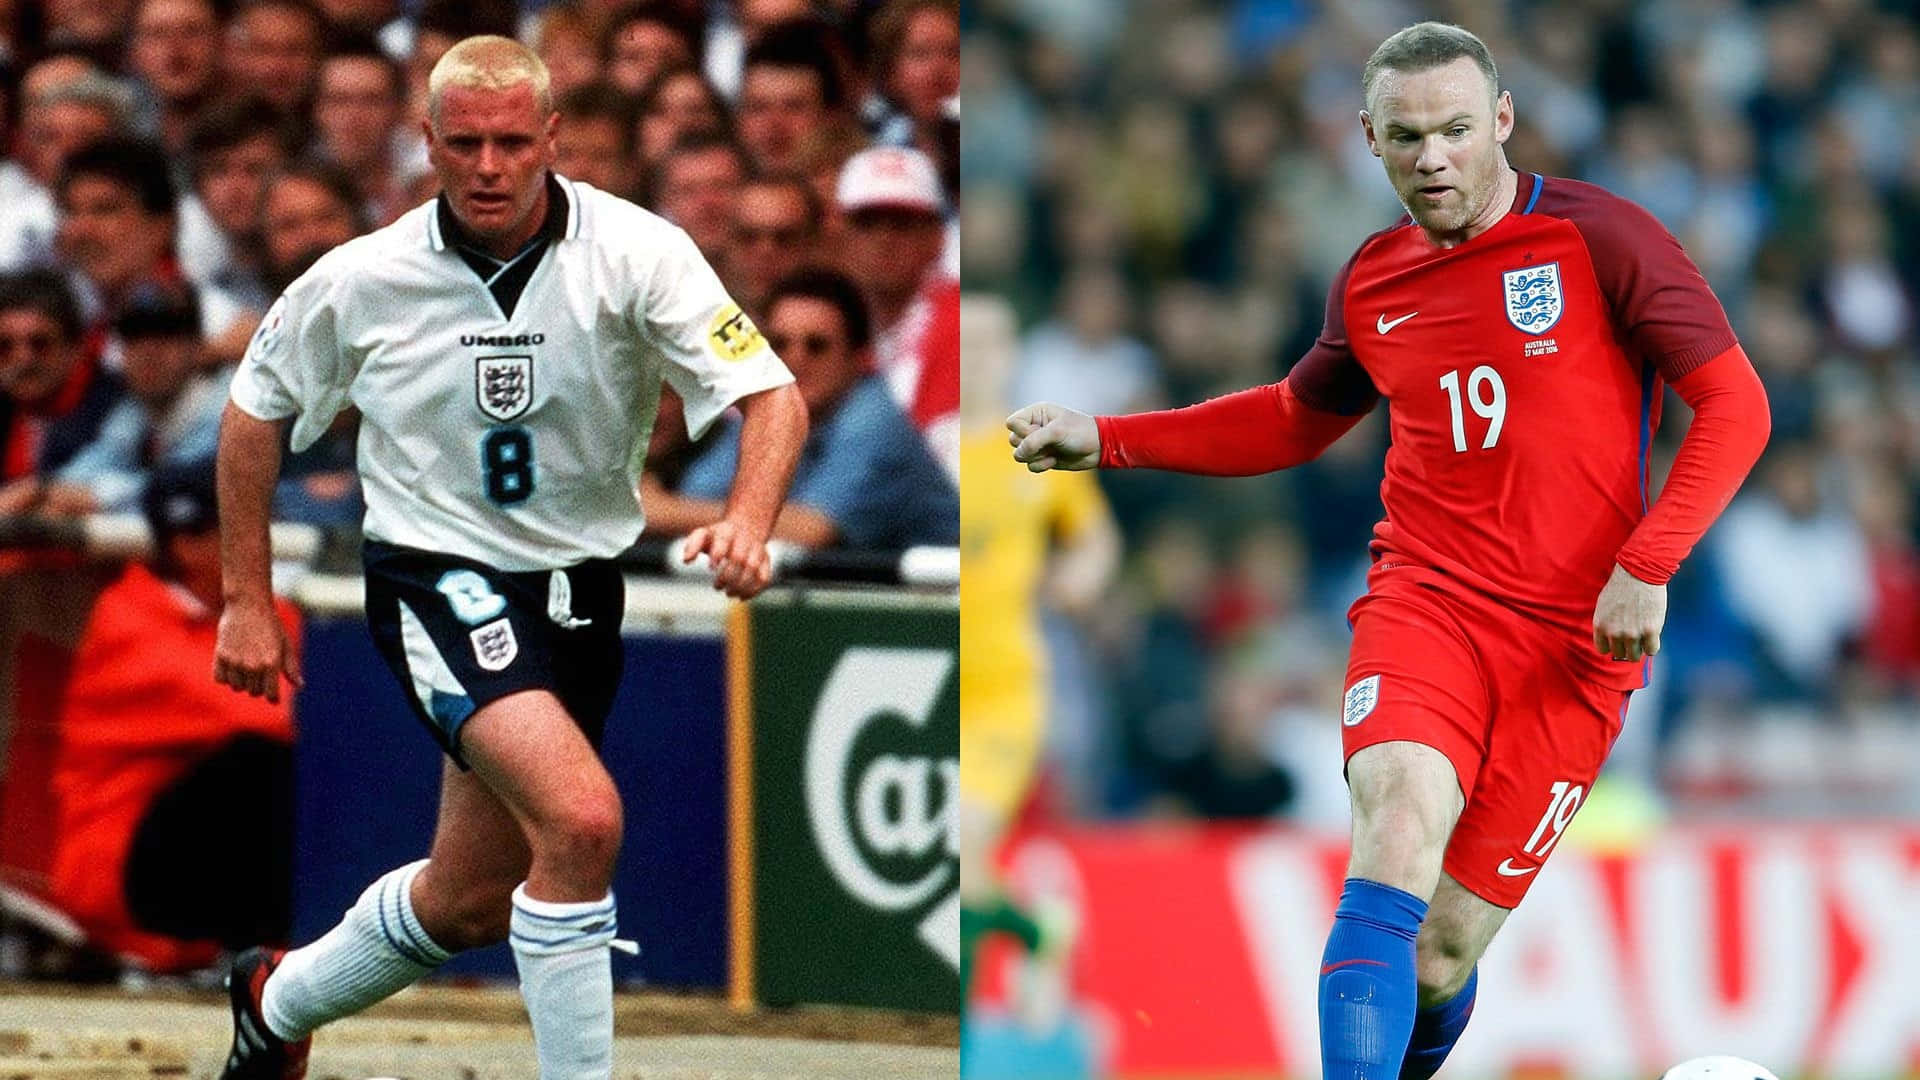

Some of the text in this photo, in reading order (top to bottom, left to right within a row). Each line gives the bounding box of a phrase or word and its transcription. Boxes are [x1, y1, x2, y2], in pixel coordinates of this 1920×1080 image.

[460, 333, 545, 347] UMBRO
[1525, 338, 1556, 349] AUSTRALIA
[1439, 365, 1507, 452] 19
[481, 425, 534, 505] 8
[1523, 781, 1583, 857] 19
